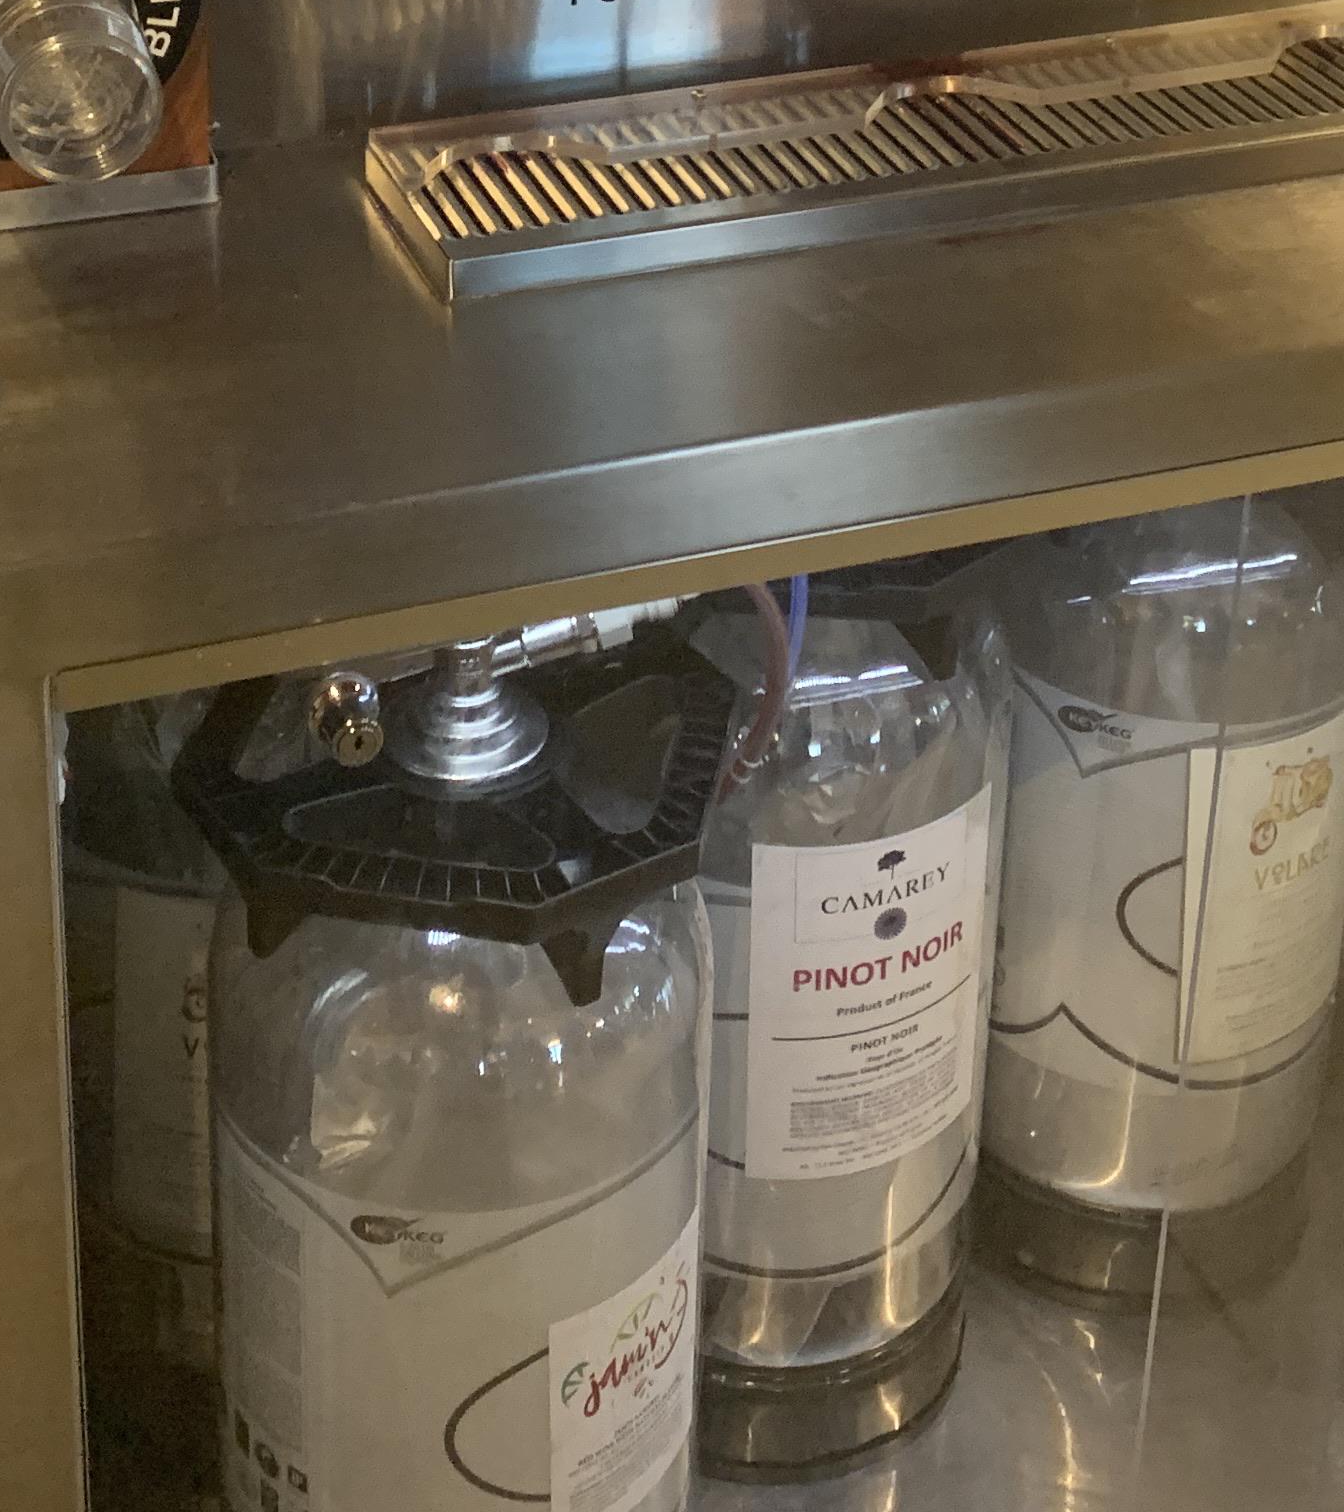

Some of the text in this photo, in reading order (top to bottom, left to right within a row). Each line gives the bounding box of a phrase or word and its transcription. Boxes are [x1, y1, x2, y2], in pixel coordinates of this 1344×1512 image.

[820, 861, 952, 915] CAMAREY
[1255, 836, 1331, 890] VOLARE
[792, 921, 964, 992] PINOT NOIR
[836, 981, 933, 1017] Product of France
[850, 1023, 919, 1054] PINOT NOIR
